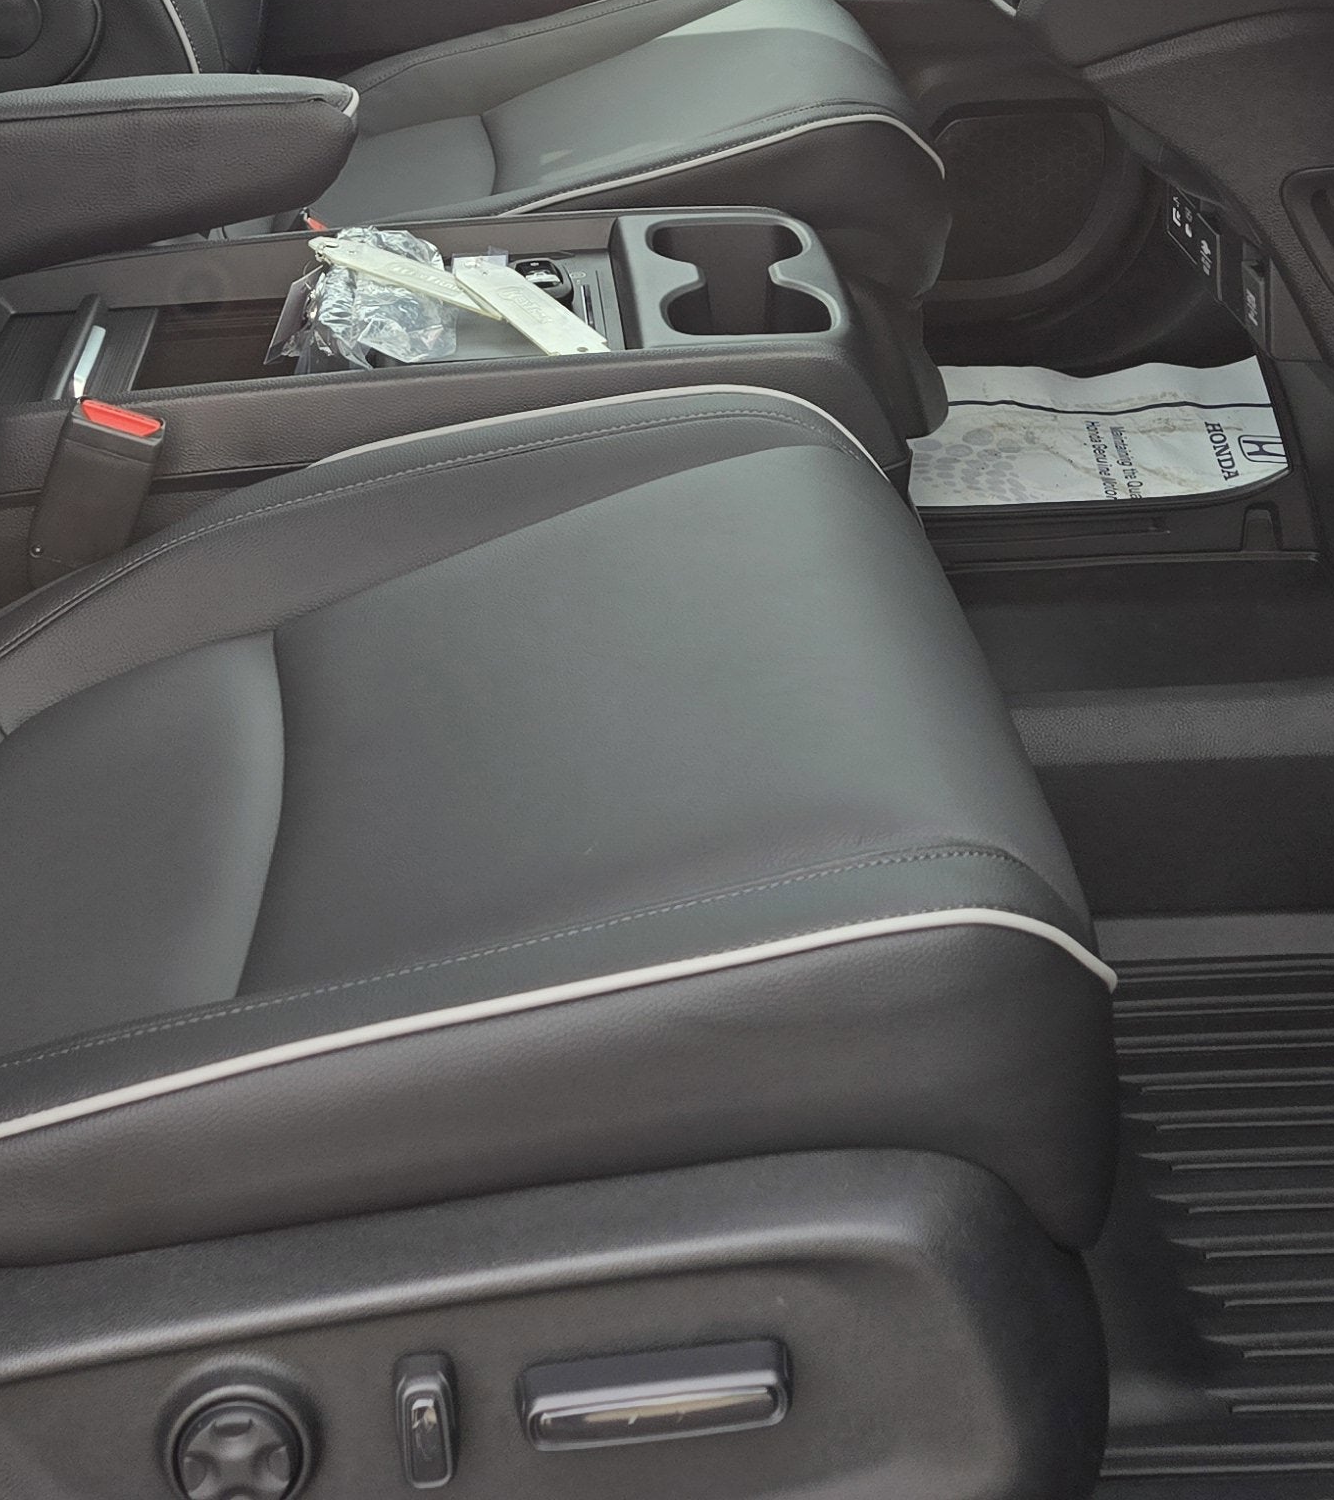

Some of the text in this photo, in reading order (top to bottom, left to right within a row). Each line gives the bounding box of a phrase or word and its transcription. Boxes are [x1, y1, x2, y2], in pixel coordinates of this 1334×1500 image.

[1085, 420, 1102, 446] Honda
[1110, 426, 1133, 470] Maintaining
[1122, 467, 1136, 483] the
[1205, 421, 1239, 481] HONDA
[1093, 443, 1111, 477] Genuine
